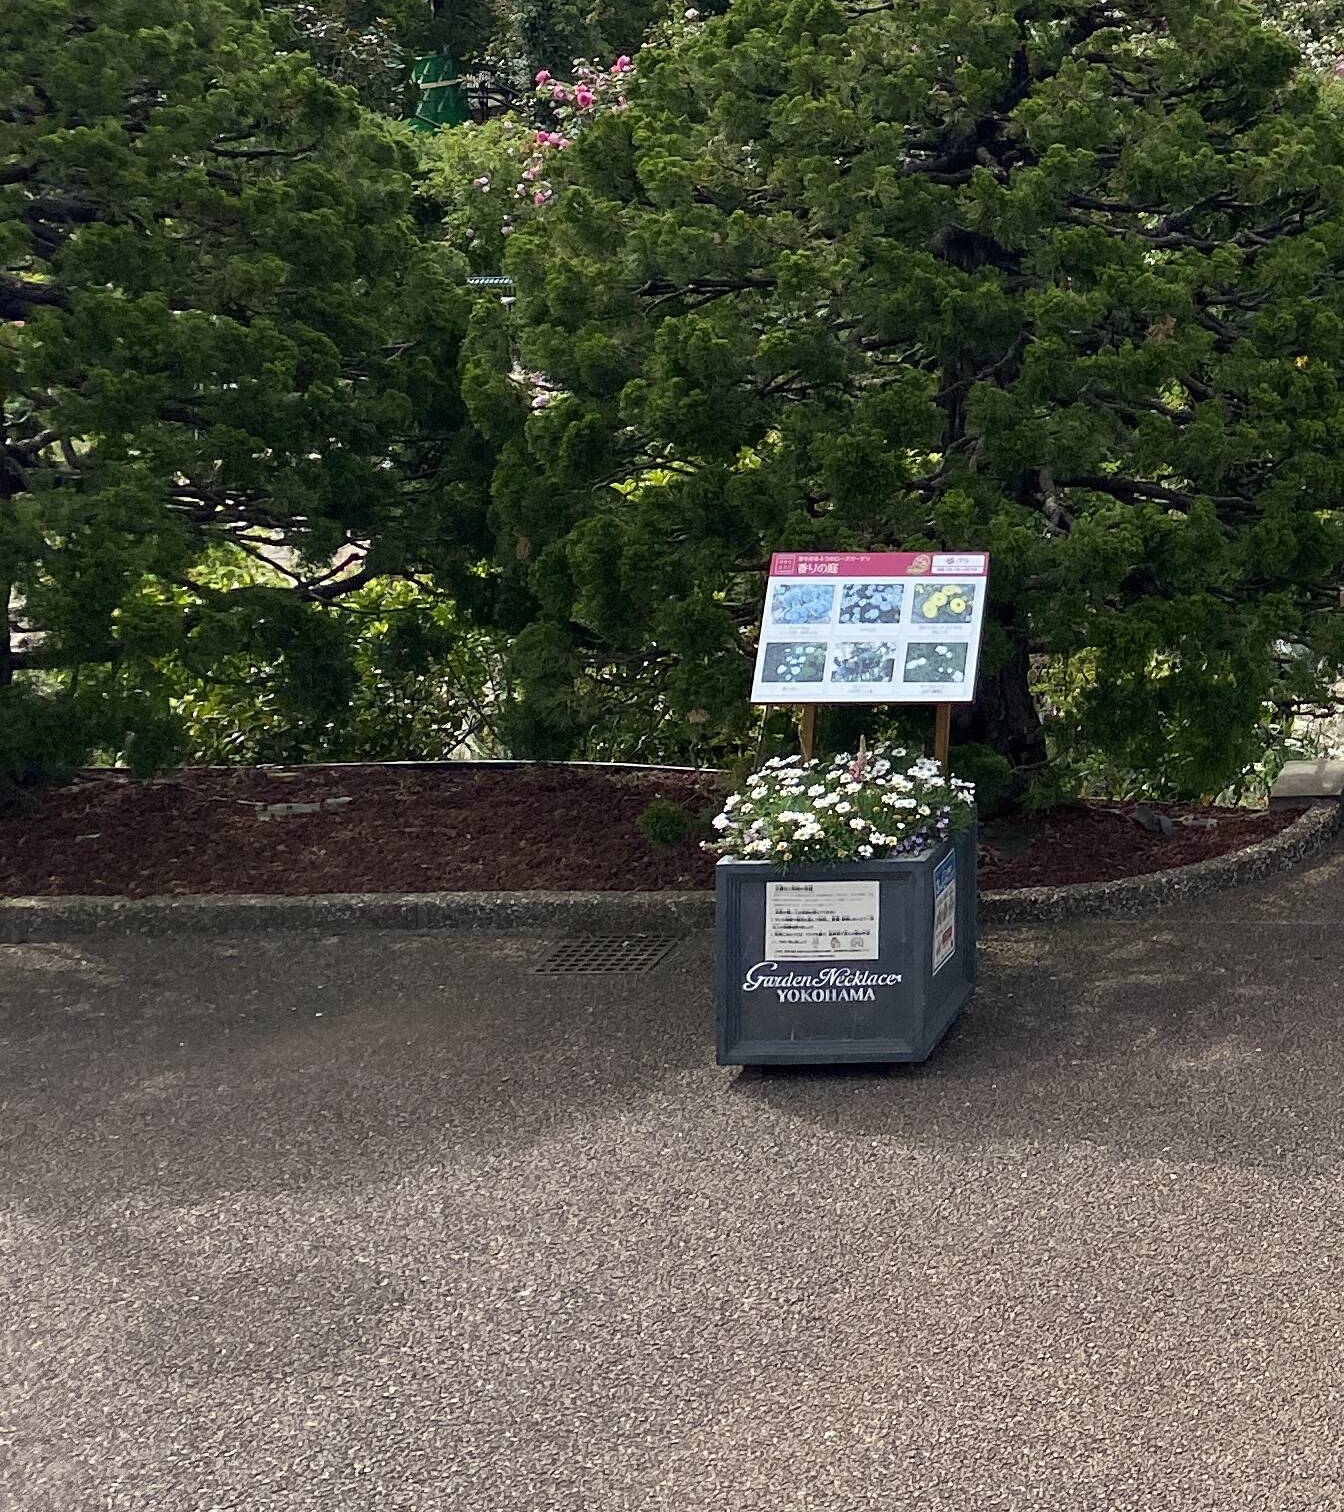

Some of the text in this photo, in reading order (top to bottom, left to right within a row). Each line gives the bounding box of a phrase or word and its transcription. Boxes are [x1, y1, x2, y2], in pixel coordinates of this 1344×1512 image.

[797, 562, 839, 574] 香りの庭
[742, 961, 901, 991] Garden Necklace
[776, 987, 877, 1003] YOKOHAMA
